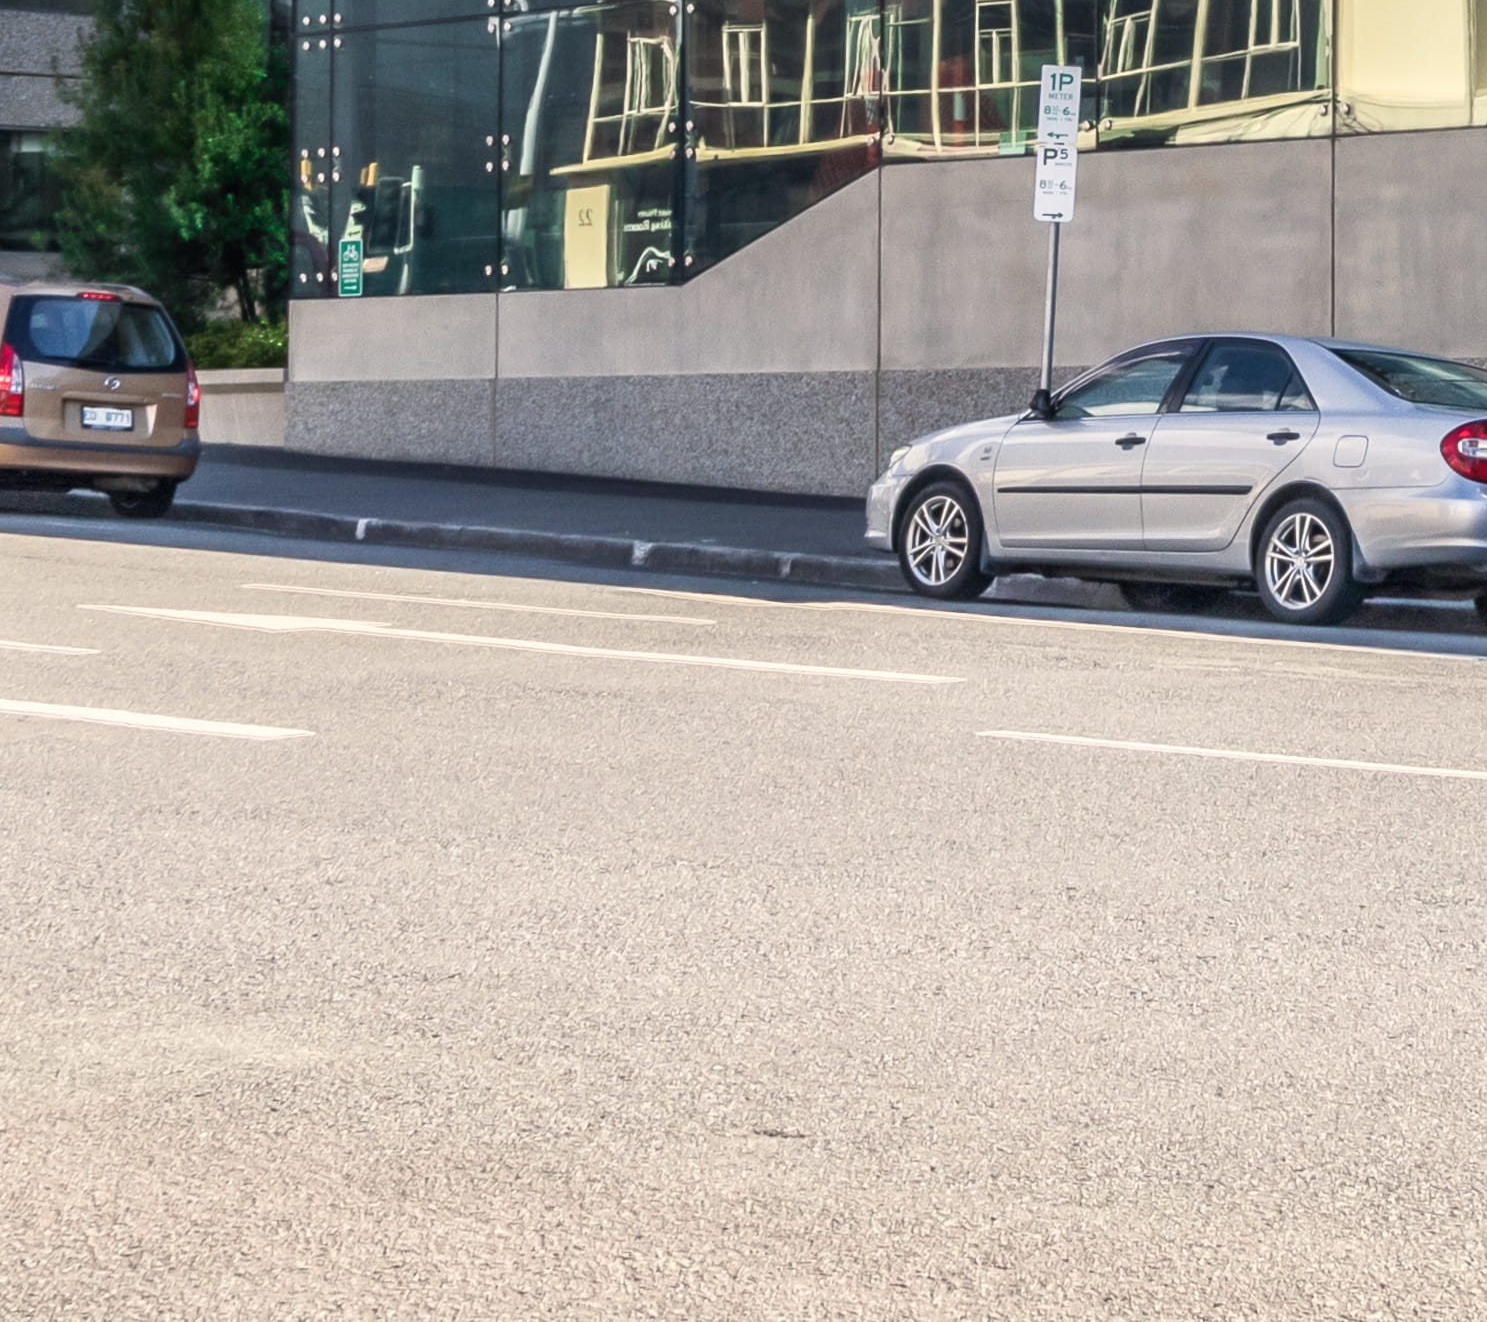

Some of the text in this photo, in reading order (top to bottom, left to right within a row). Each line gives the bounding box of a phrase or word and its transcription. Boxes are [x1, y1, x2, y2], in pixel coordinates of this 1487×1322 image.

[1050, 72, 1074, 91] 1P
[1044, 105, 1052, 115] 8
[1062, 106, 1070, 116] 6
